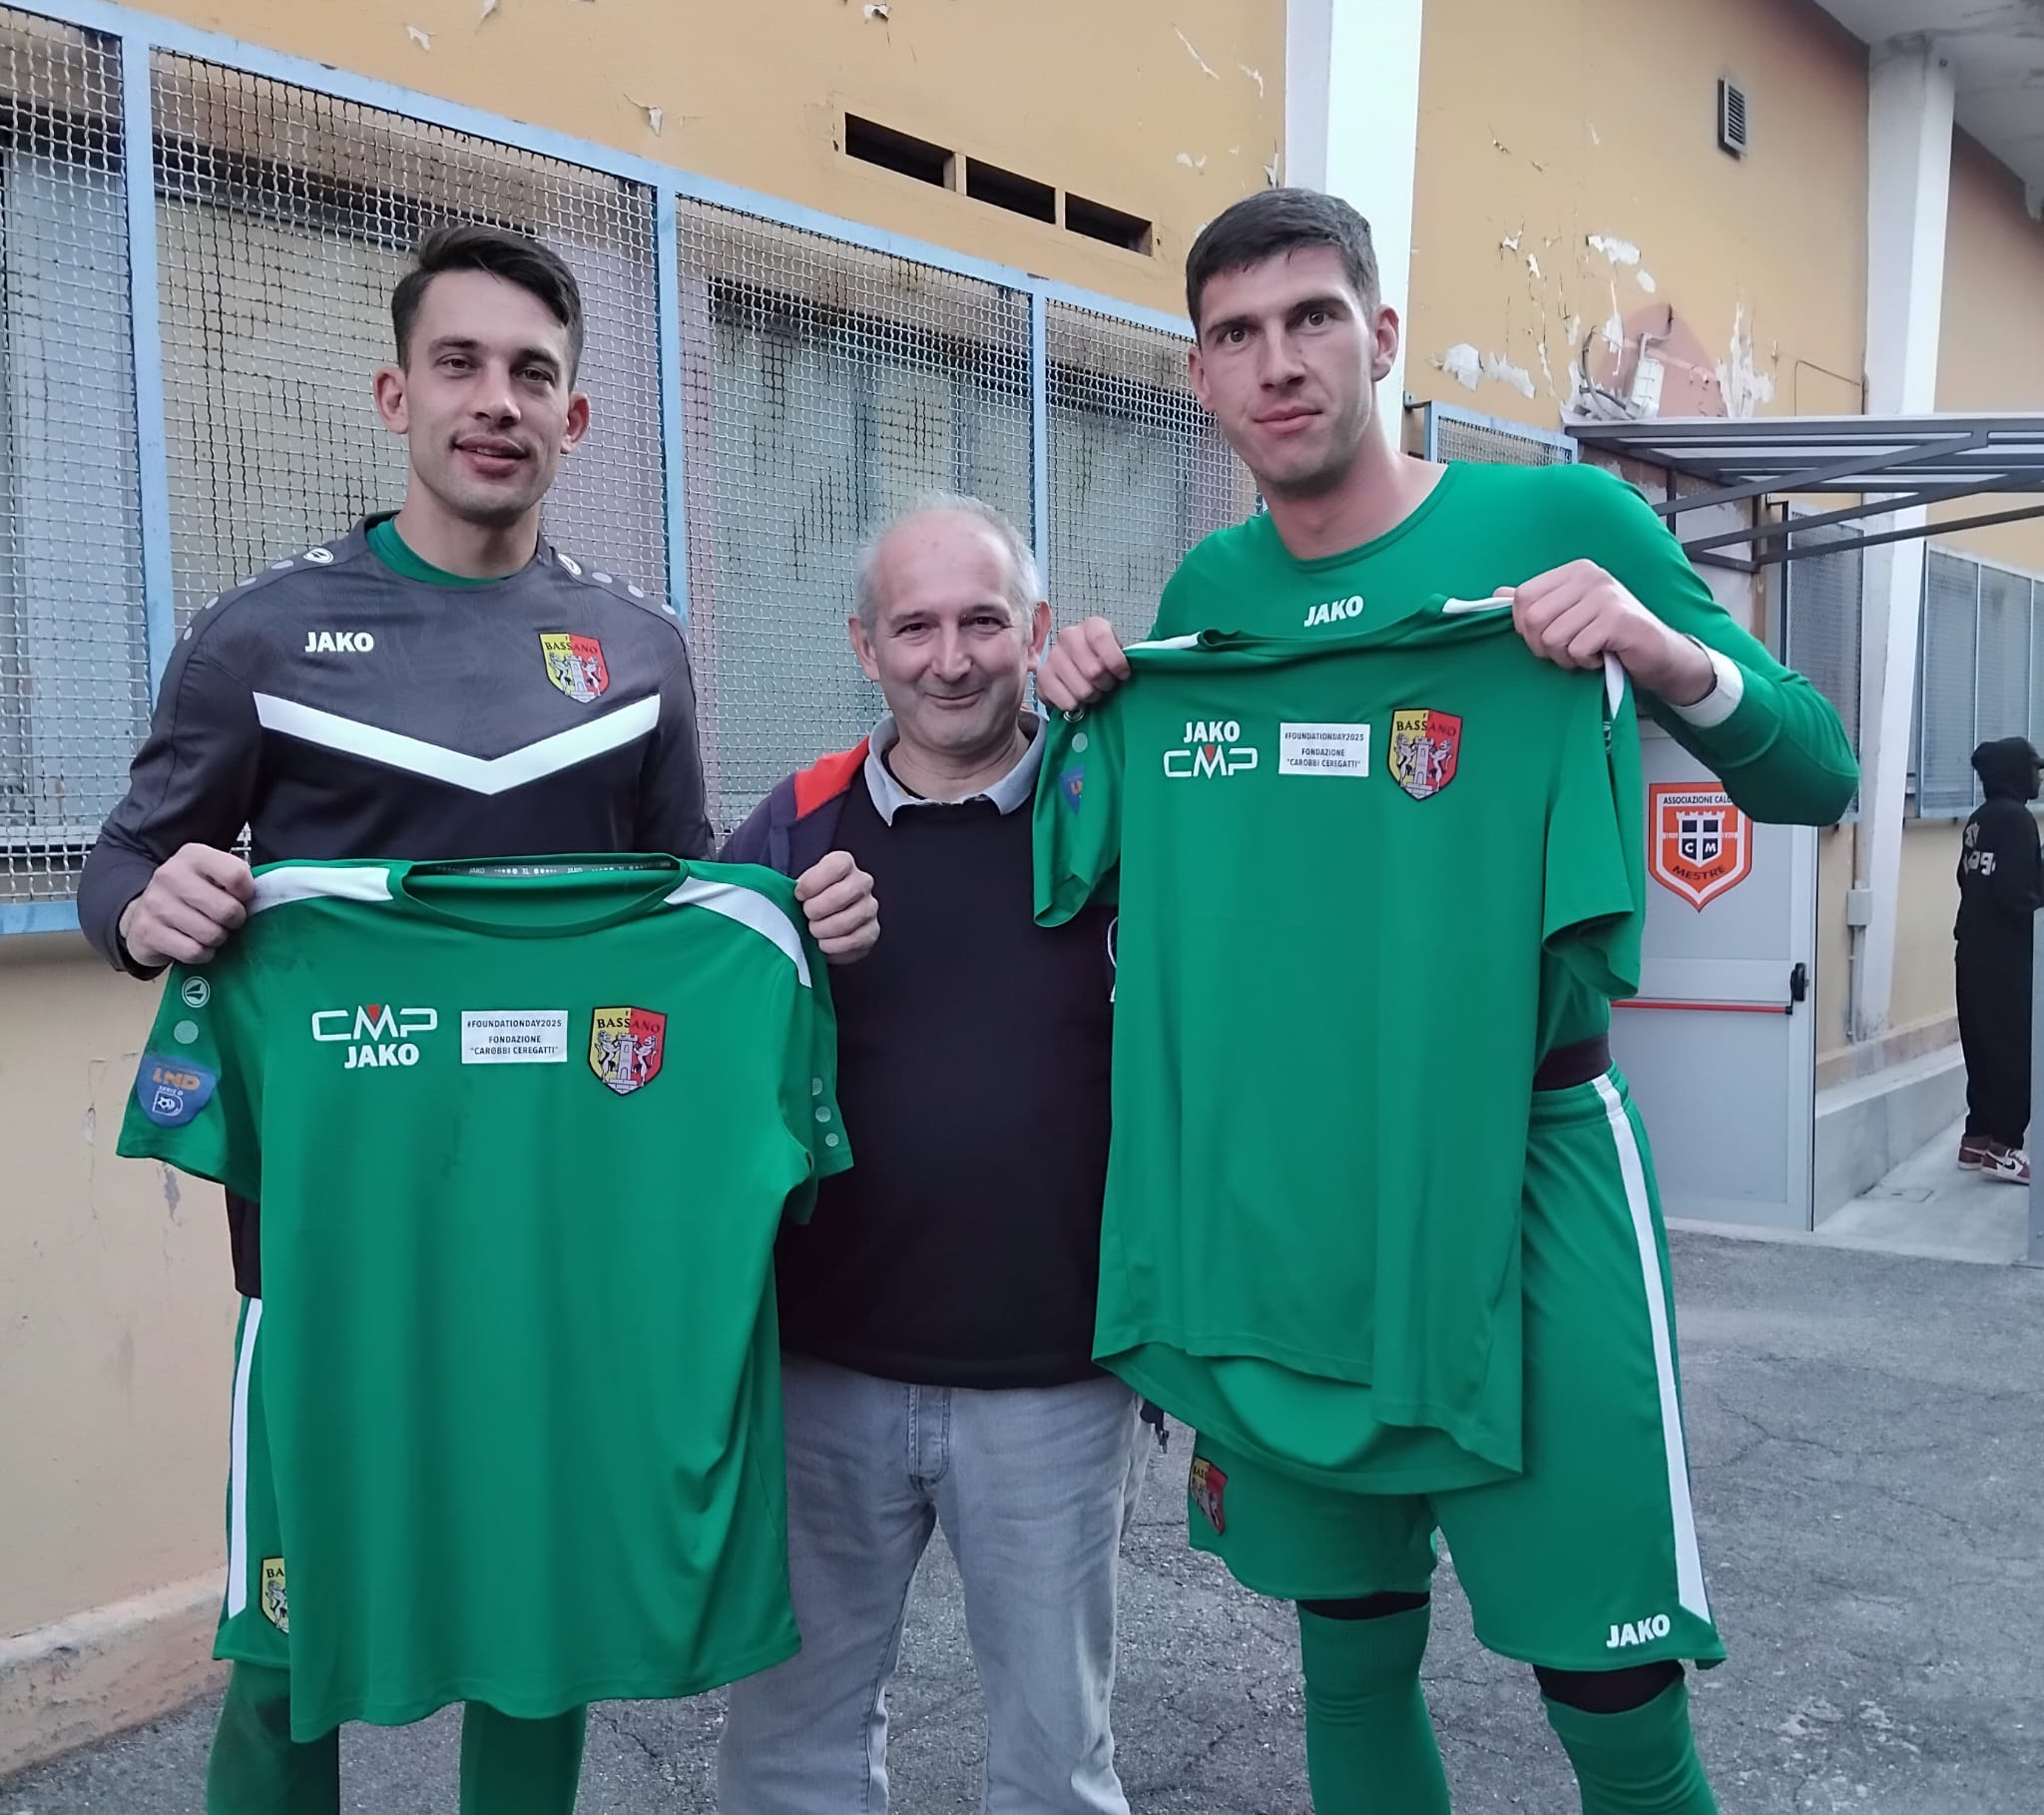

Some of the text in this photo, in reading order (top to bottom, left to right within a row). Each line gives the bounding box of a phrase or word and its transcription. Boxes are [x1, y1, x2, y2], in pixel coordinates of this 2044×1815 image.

[1303, 595, 1364, 628] JAKO
[304, 631, 374, 654] JAKO
[544, 642, 598, 654] BASSANO
[1184, 719, 1240, 743] JAKO
[1284, 731, 1364, 741] #FOUNDATIONDAY2025
[1396, 719, 1457, 736] BASSANO
[1301, 747, 1345, 756] FONDAZIONE
[1164, 744, 1259, 779] CMP
[1663, 795, 1713, 804] ASSOCIAZIONE
[1685, 842, 1717, 853] C M
[1673, 865, 1726, 880] MESTRE
[311, 1004, 437, 1041] CMP
[597, 1017, 661, 1033] BASSANO
[488, 1035, 541, 1044] FONDAZIONE
[344, 1044, 420, 1069] JAKO
[153, 1068, 201, 1091] LND
[1606, 1613, 1671, 1648] JAKO
